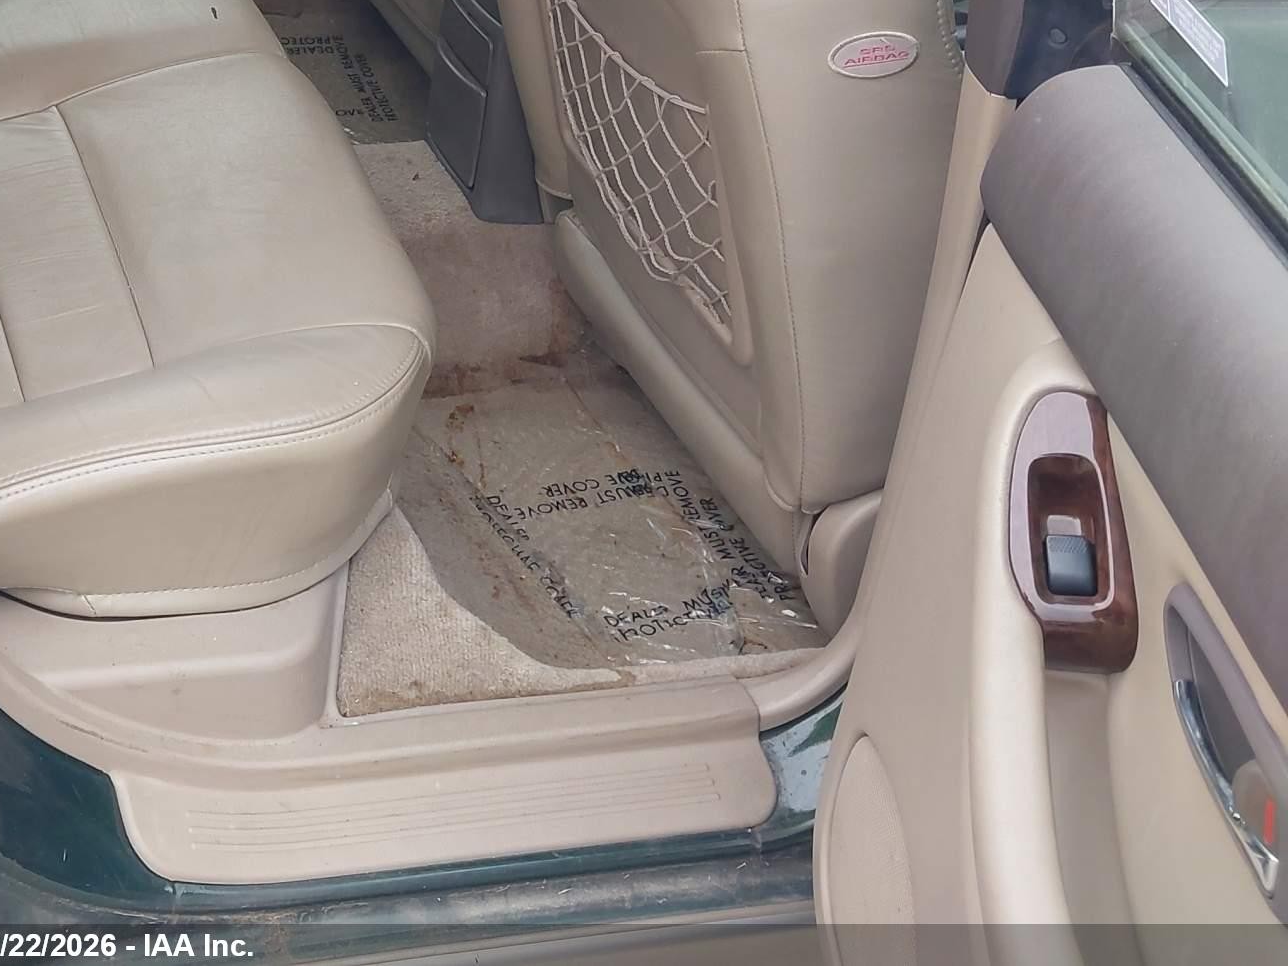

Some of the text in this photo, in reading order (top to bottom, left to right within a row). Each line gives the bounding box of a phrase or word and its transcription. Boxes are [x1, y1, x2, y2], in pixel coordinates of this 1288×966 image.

[541, 479, 600, 498] COVER
[514, 498, 589, 520] REMOVE
[699, 526, 736, 561] MUST
